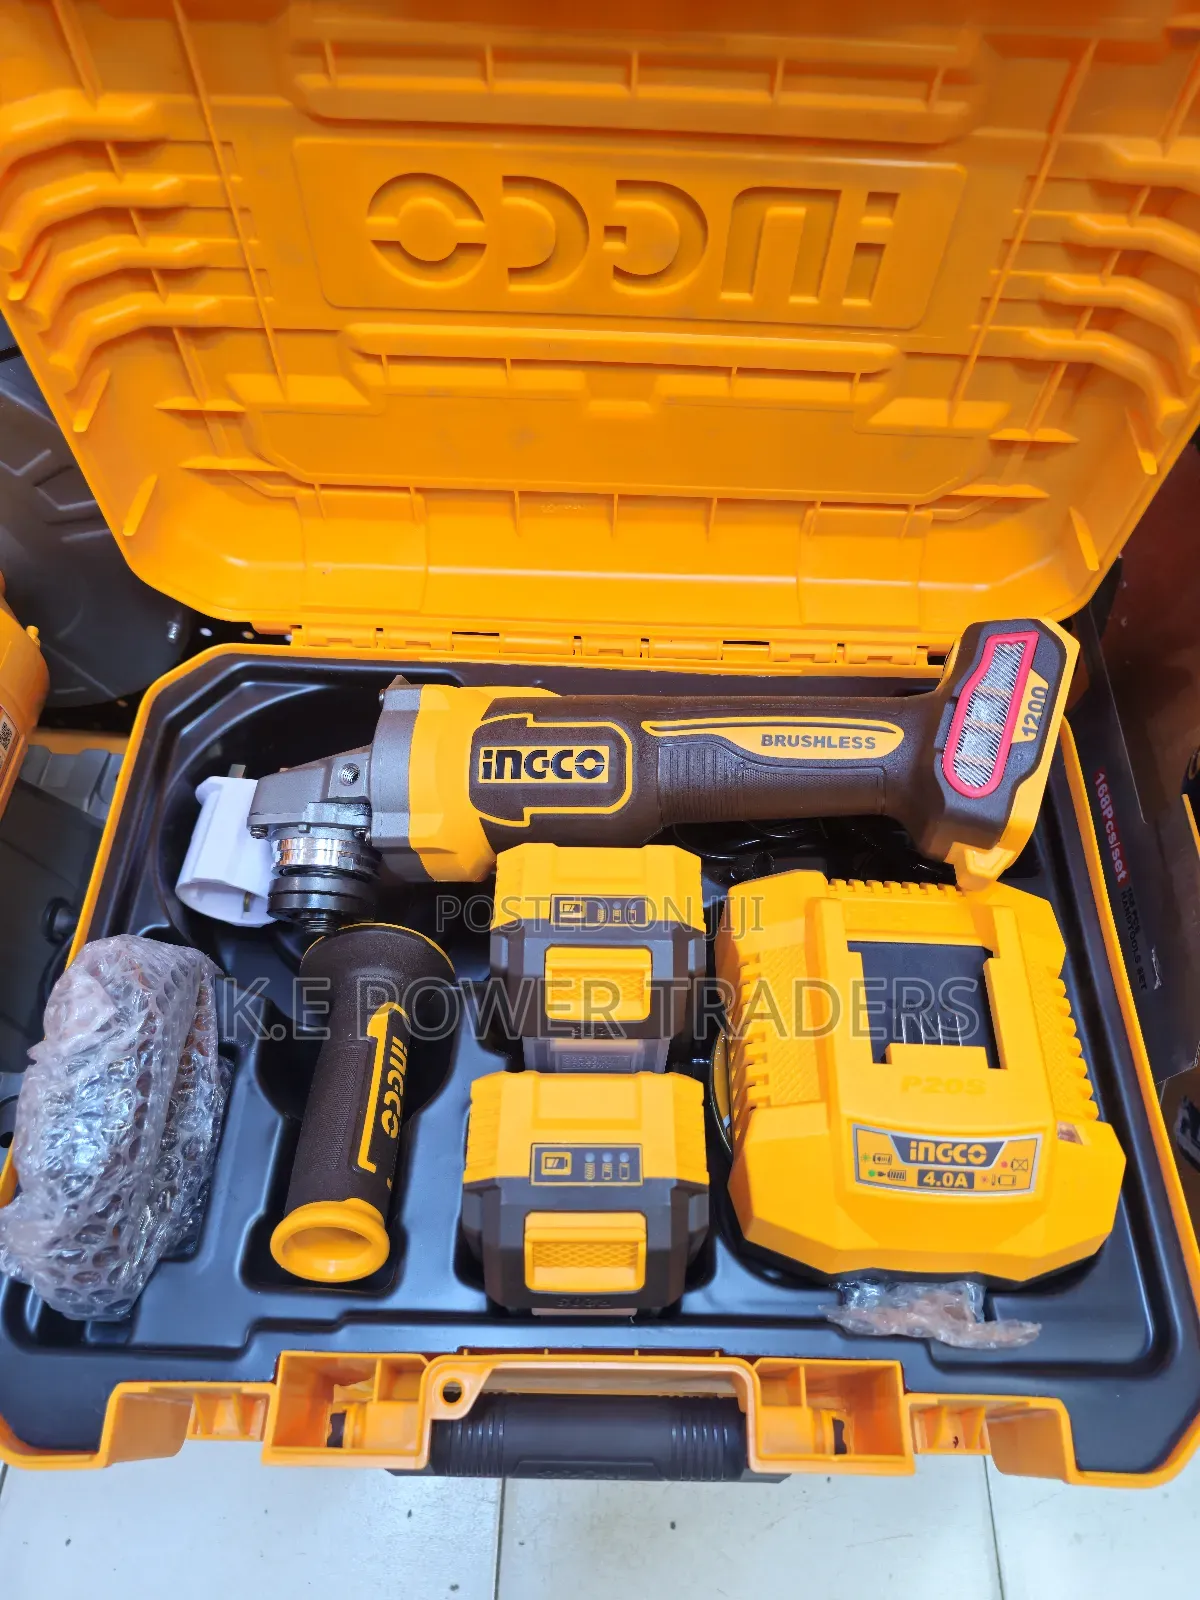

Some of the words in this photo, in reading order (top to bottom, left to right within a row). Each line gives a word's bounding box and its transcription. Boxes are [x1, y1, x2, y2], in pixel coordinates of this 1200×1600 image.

[1021, 686, 1049, 737] 1200
[760, 733, 877, 750] BRUSHLESS
[901, 1075, 987, 1096] P20S
[922, 1171, 969, 1189] 4.0A
